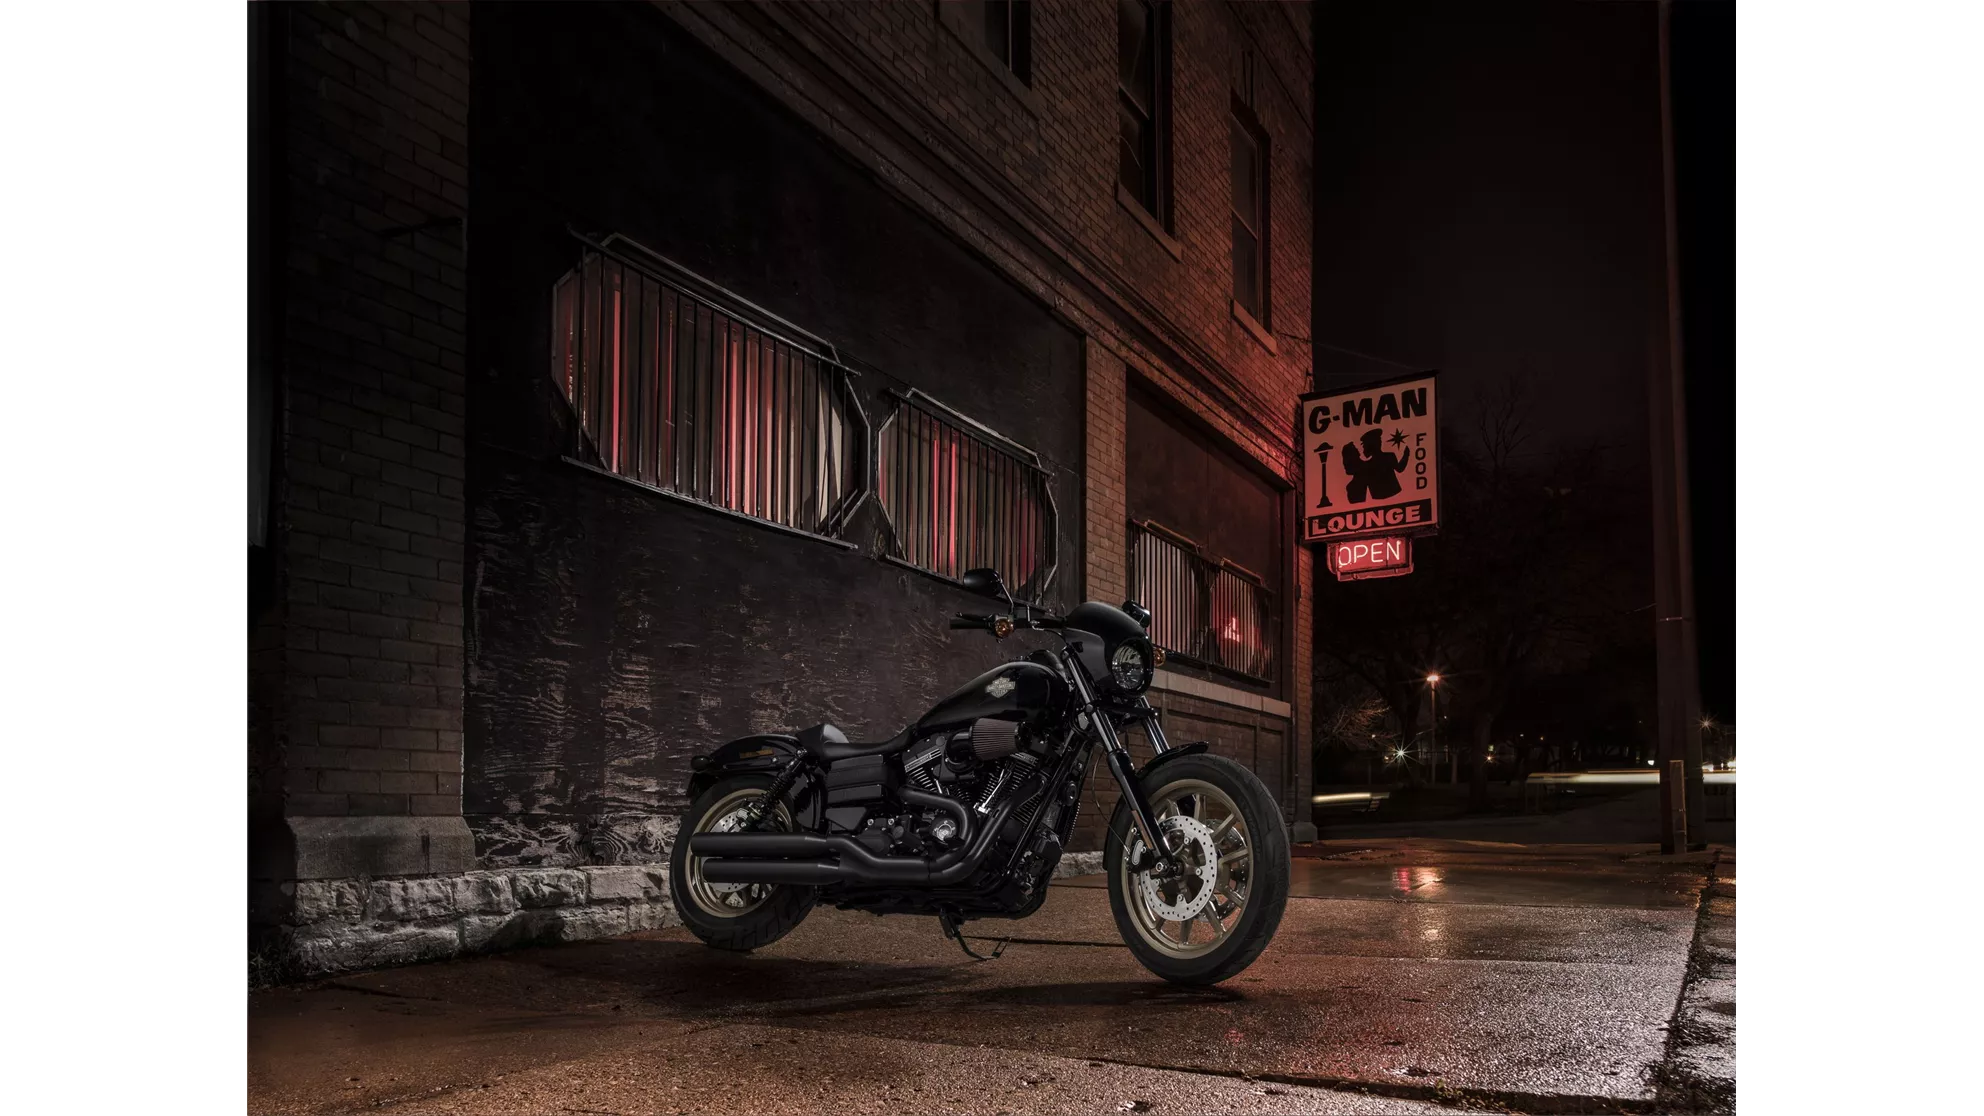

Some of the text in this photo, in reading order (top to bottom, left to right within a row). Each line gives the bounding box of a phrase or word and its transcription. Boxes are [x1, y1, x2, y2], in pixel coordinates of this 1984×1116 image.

[1309, 388, 1427, 434] G-MAN
[1415, 433, 1428, 490] FOOD
[1312, 504, 1421, 535] LOUNGE
[1338, 541, 1401, 568] OPEN
